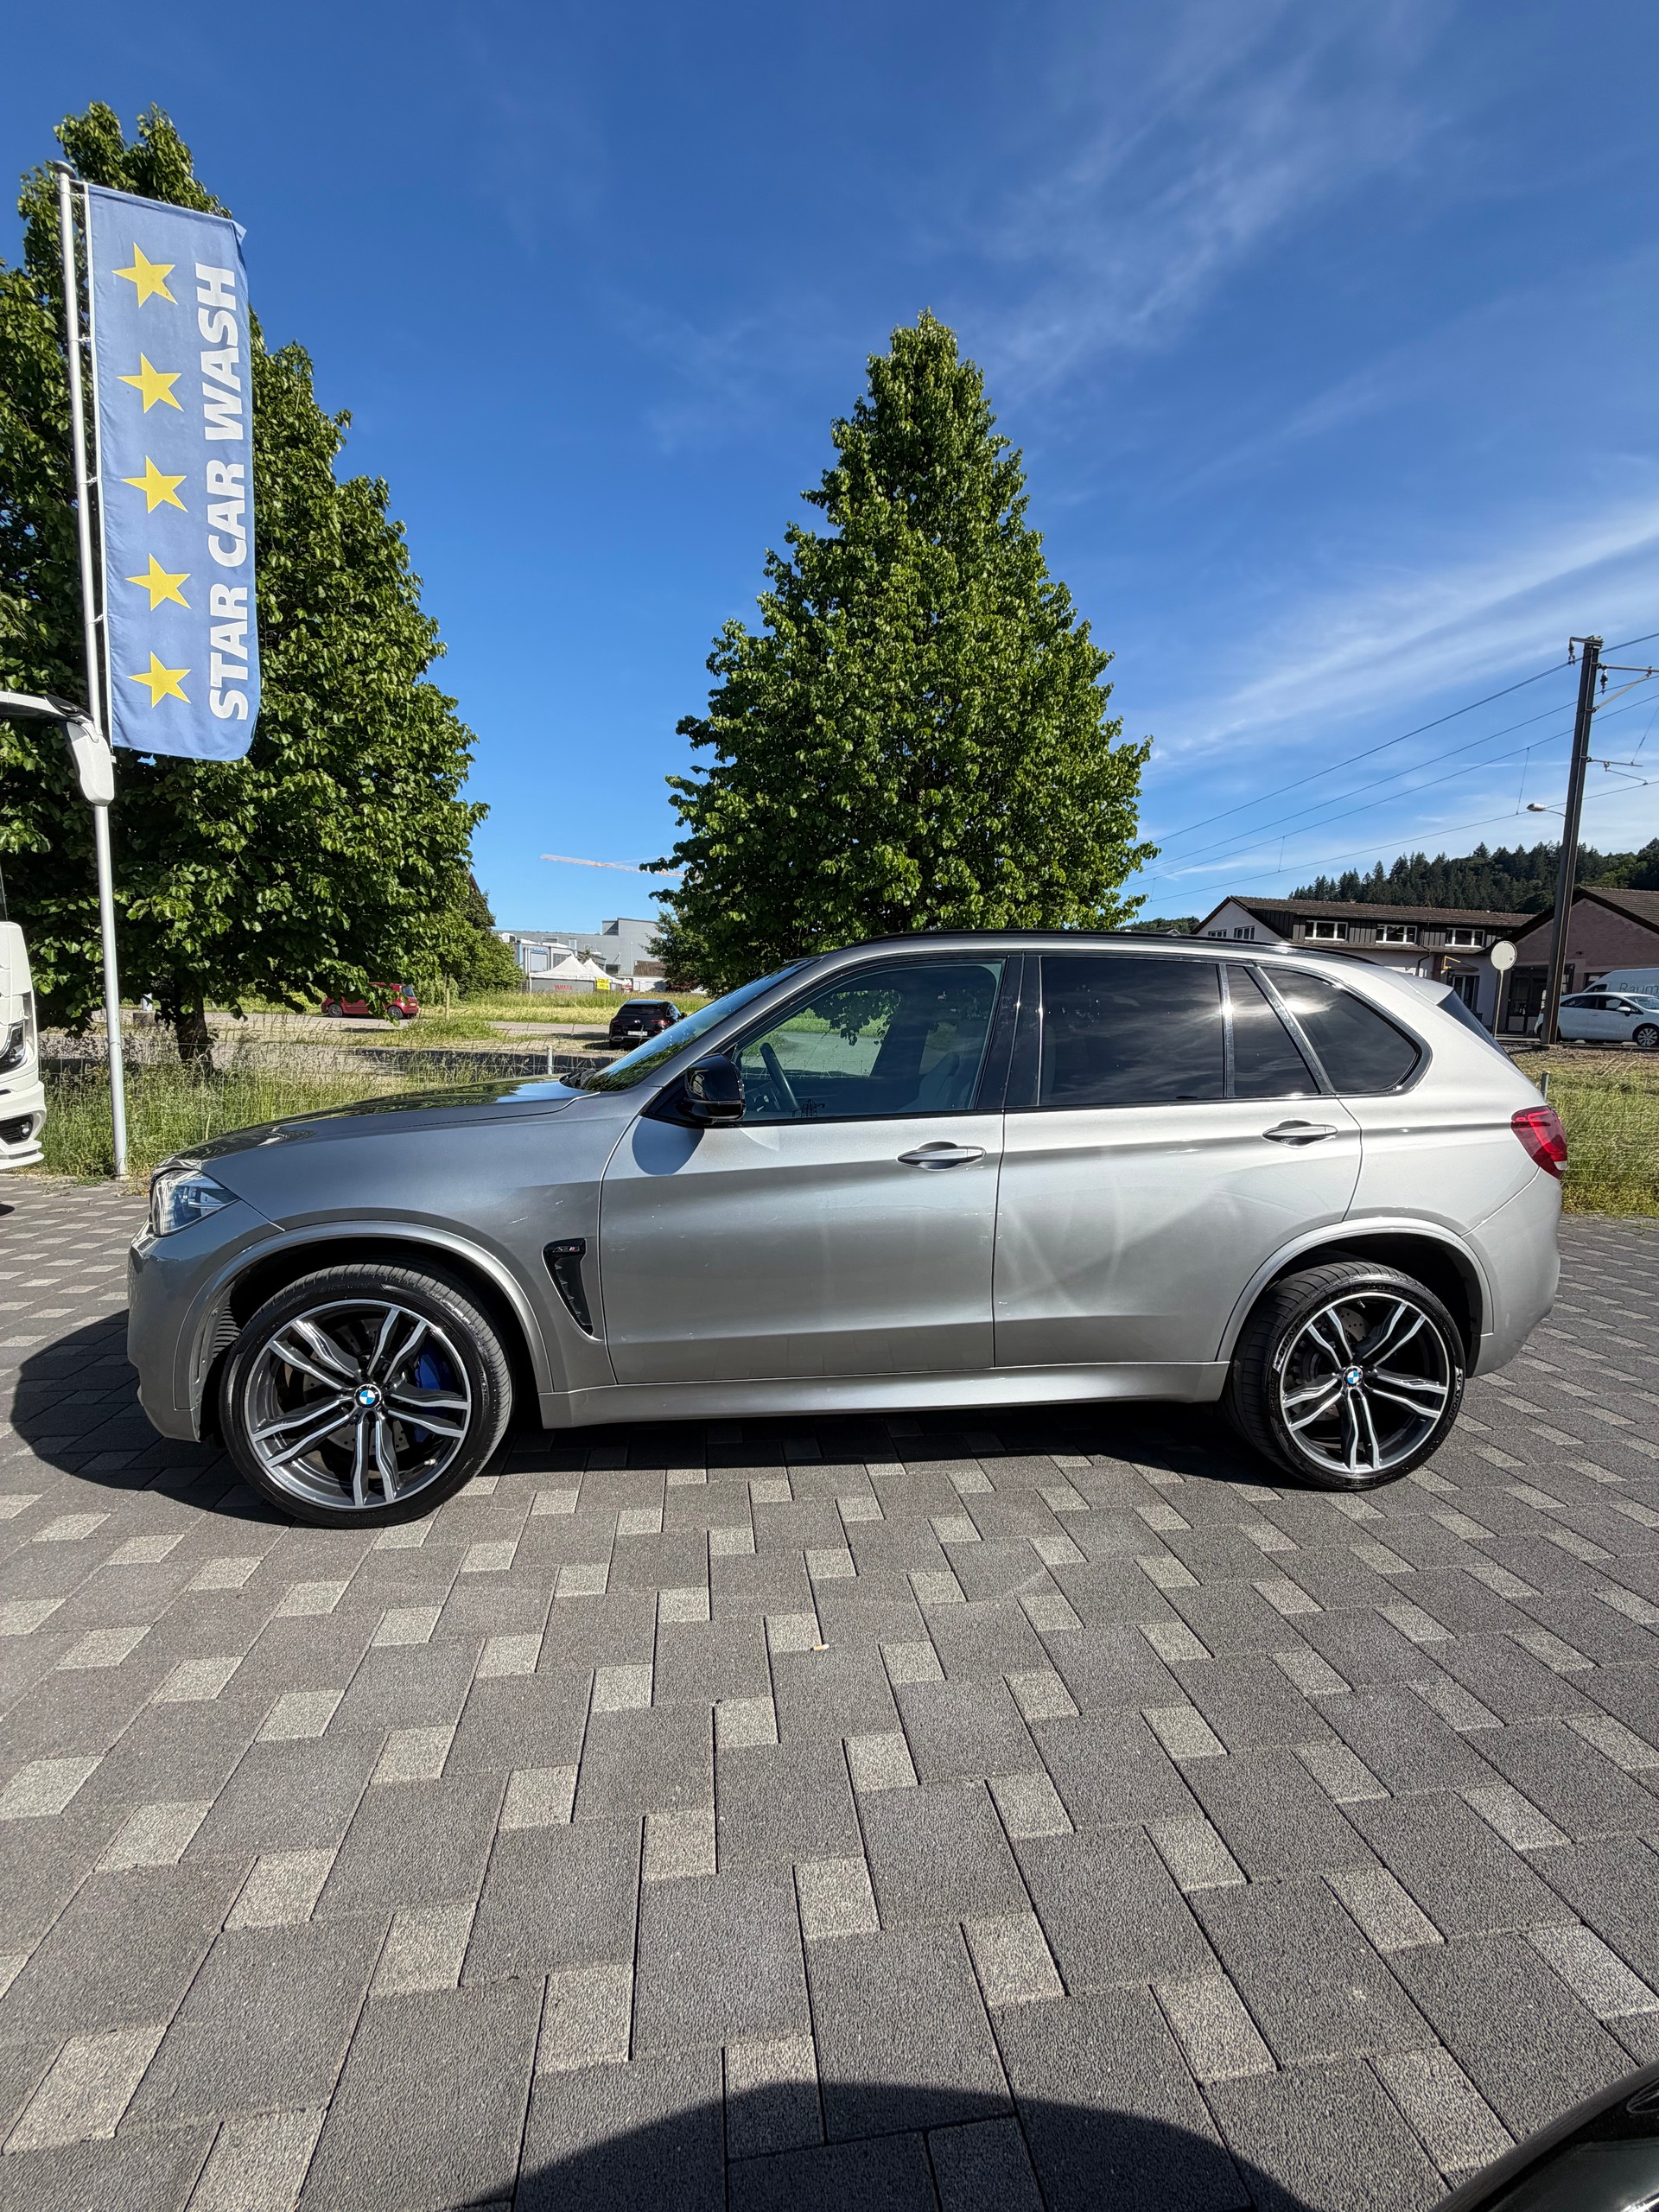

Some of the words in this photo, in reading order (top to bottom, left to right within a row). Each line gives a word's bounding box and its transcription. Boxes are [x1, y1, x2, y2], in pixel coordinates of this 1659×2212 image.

[195, 264, 243, 441] WASH
[207, 459, 247, 568] CAR
[209, 583, 248, 721] STAR
